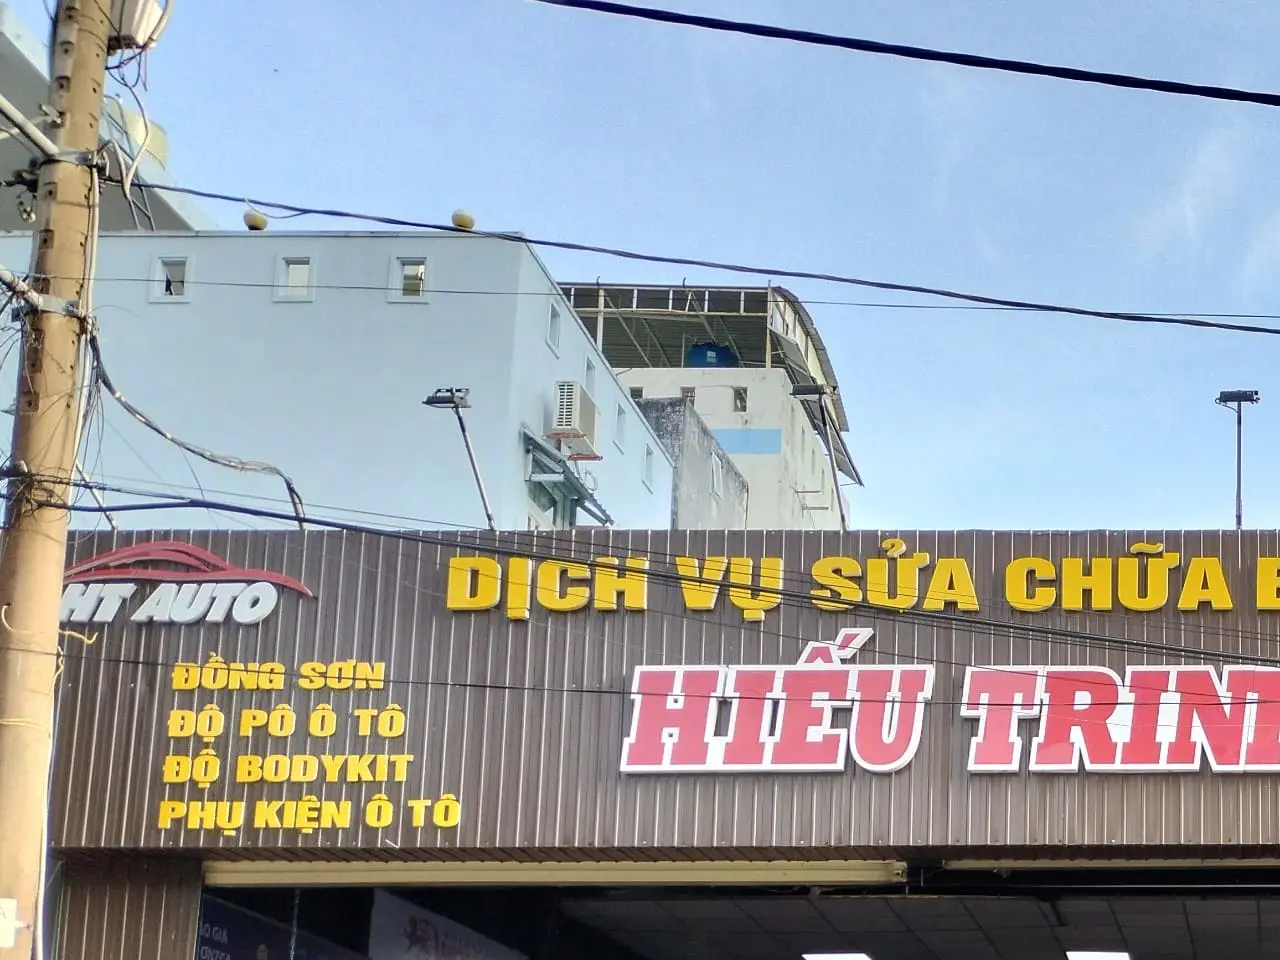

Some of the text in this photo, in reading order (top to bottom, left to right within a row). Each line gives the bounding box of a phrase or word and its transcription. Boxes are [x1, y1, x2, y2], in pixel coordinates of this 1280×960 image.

[447, 556, 649, 621] DỊCH
[675, 556, 783, 622] VỤ
[810, 538, 980, 613] SỬA
[1005, 541, 1232, 613] CHỮA
[60, 581, 278, 625] HT AUTO
[172, 651, 386, 690] ĐỒNG SƠN
[620, 627, 935, 774] HIẾU
[167, 703, 406, 743] ĐỘ PÔ Ô TÔ
[162, 748, 414, 788] ĐỘ BODYKIT
[158, 793, 460, 836] PHỤ KIỆN Ô TÔ
